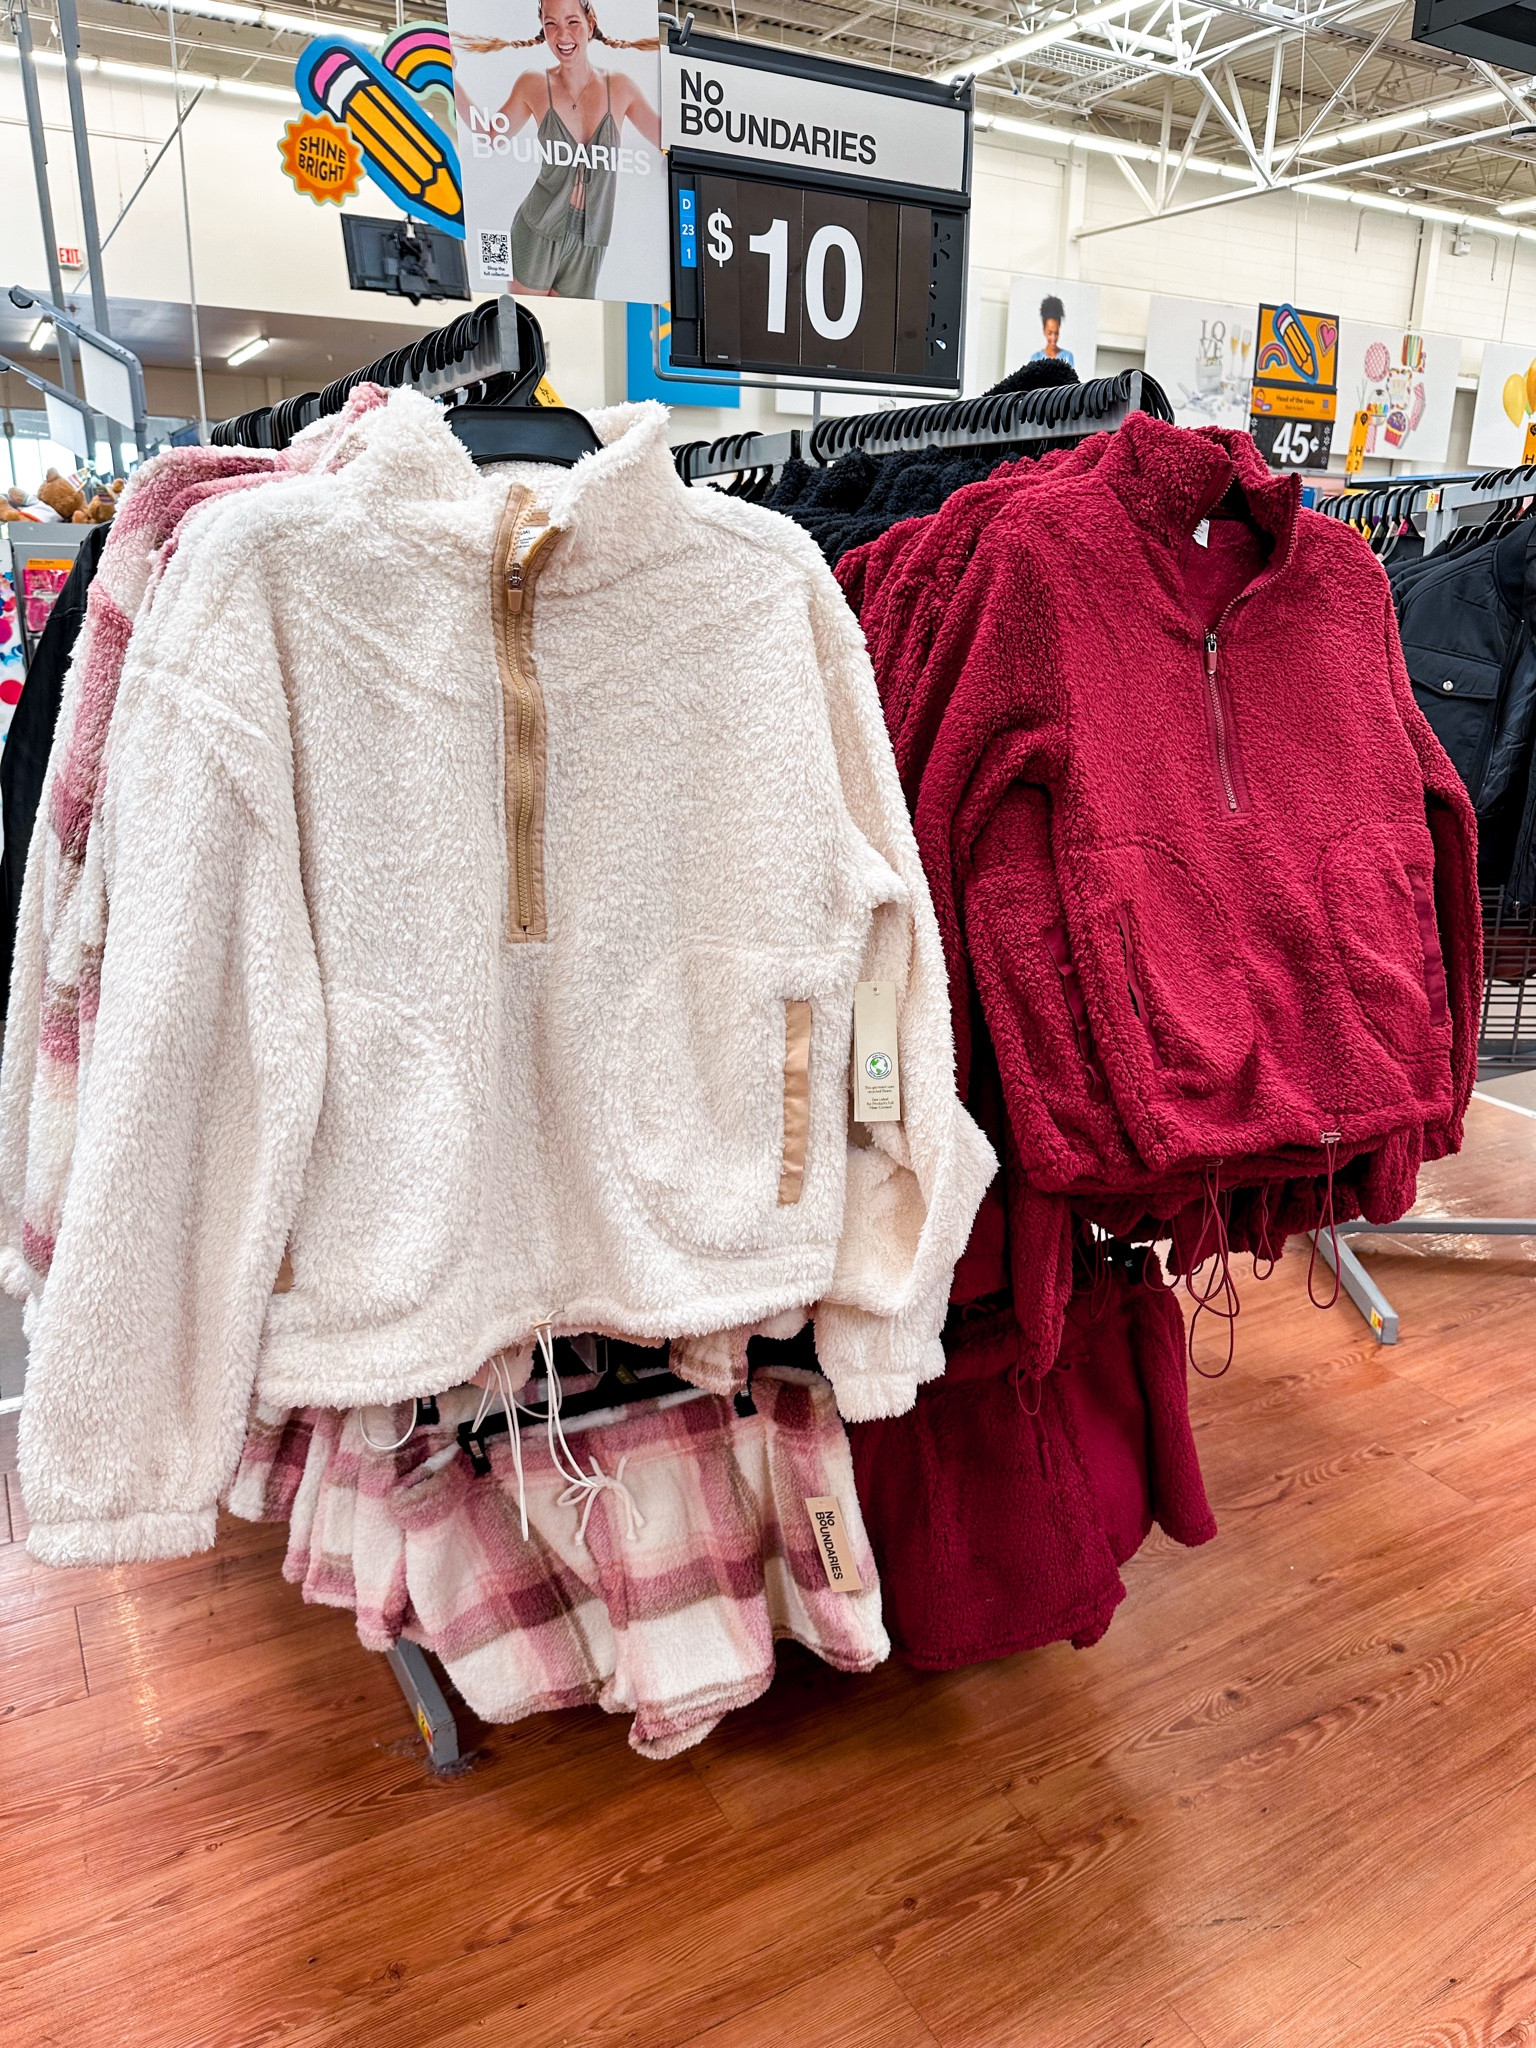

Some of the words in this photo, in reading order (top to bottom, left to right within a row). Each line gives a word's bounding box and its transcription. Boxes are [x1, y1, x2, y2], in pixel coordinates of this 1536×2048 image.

[299, 136, 347, 164] SHINE
[298, 153, 345, 182] BRIGHT
[682, 199, 691, 210] D
[681, 224, 695, 236] 23
[59, 247, 79, 264] EXIT
[686, 248, 692, 259] 1
[1355, 445, 1363, 456] H
[1354, 460, 1359, 471] 2
